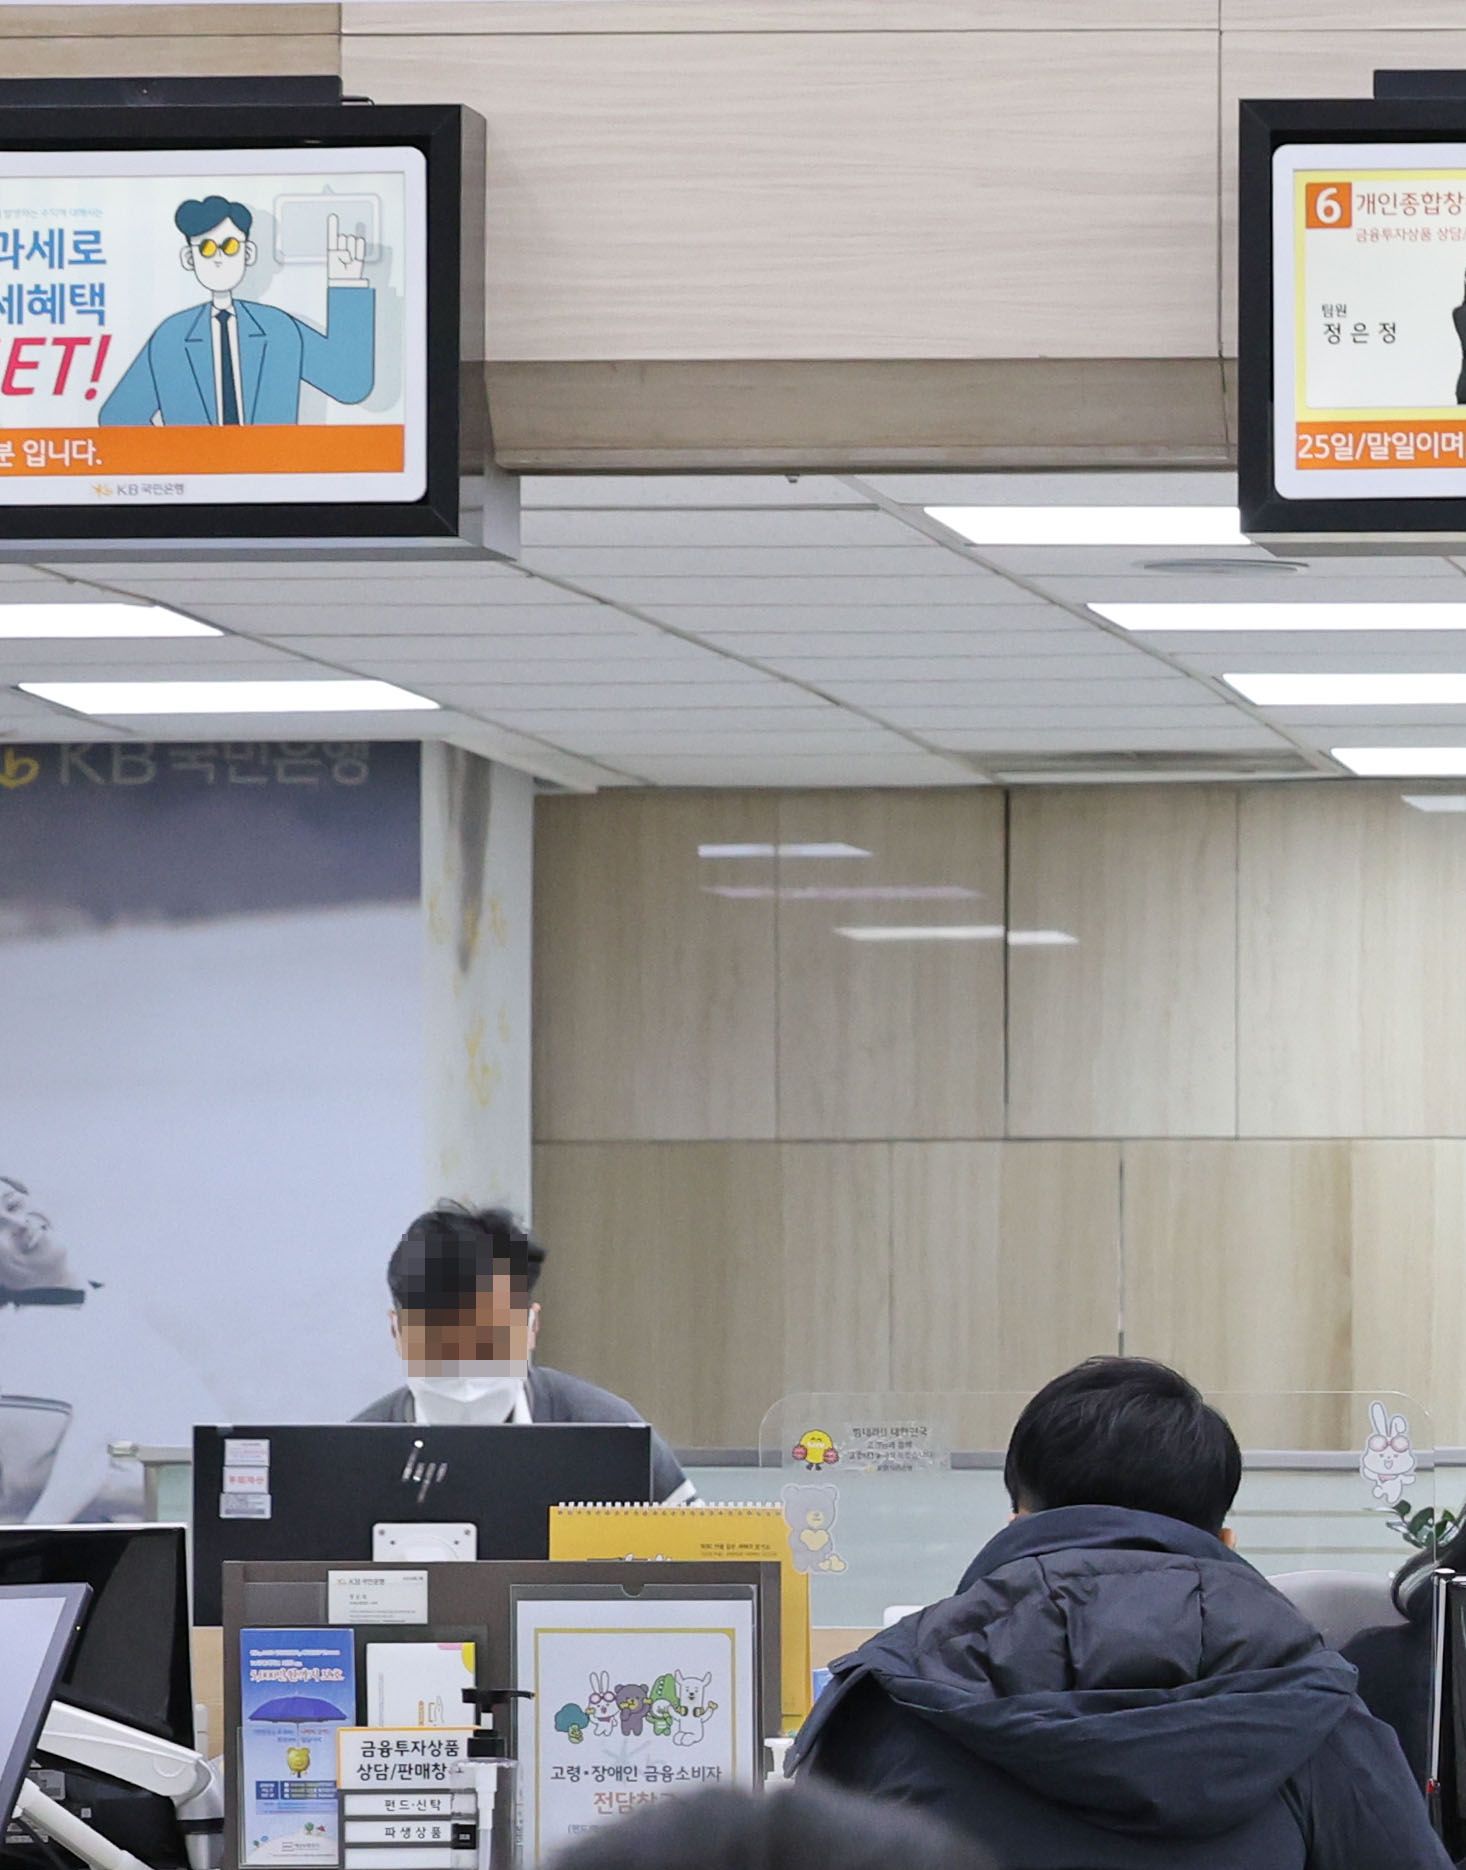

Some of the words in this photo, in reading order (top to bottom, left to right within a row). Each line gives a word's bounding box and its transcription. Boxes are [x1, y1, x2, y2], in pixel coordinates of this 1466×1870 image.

[1315, 187, 1343, 225] 6
[1356, 227, 1432, 243] 금융투자상품
[1321, 303, 1348, 318] 팀원
[0, 334, 112, 401] ET!
[23, 439, 102, 468] 입니다.
[117, 485, 138, 497] KB
[141, 483, 185, 497] 국민은행
[58, 742, 156, 785] KB
[360, 1740, 460, 1758] 금융투자상품
[643, 1765, 722, 1783] 금융소비자
